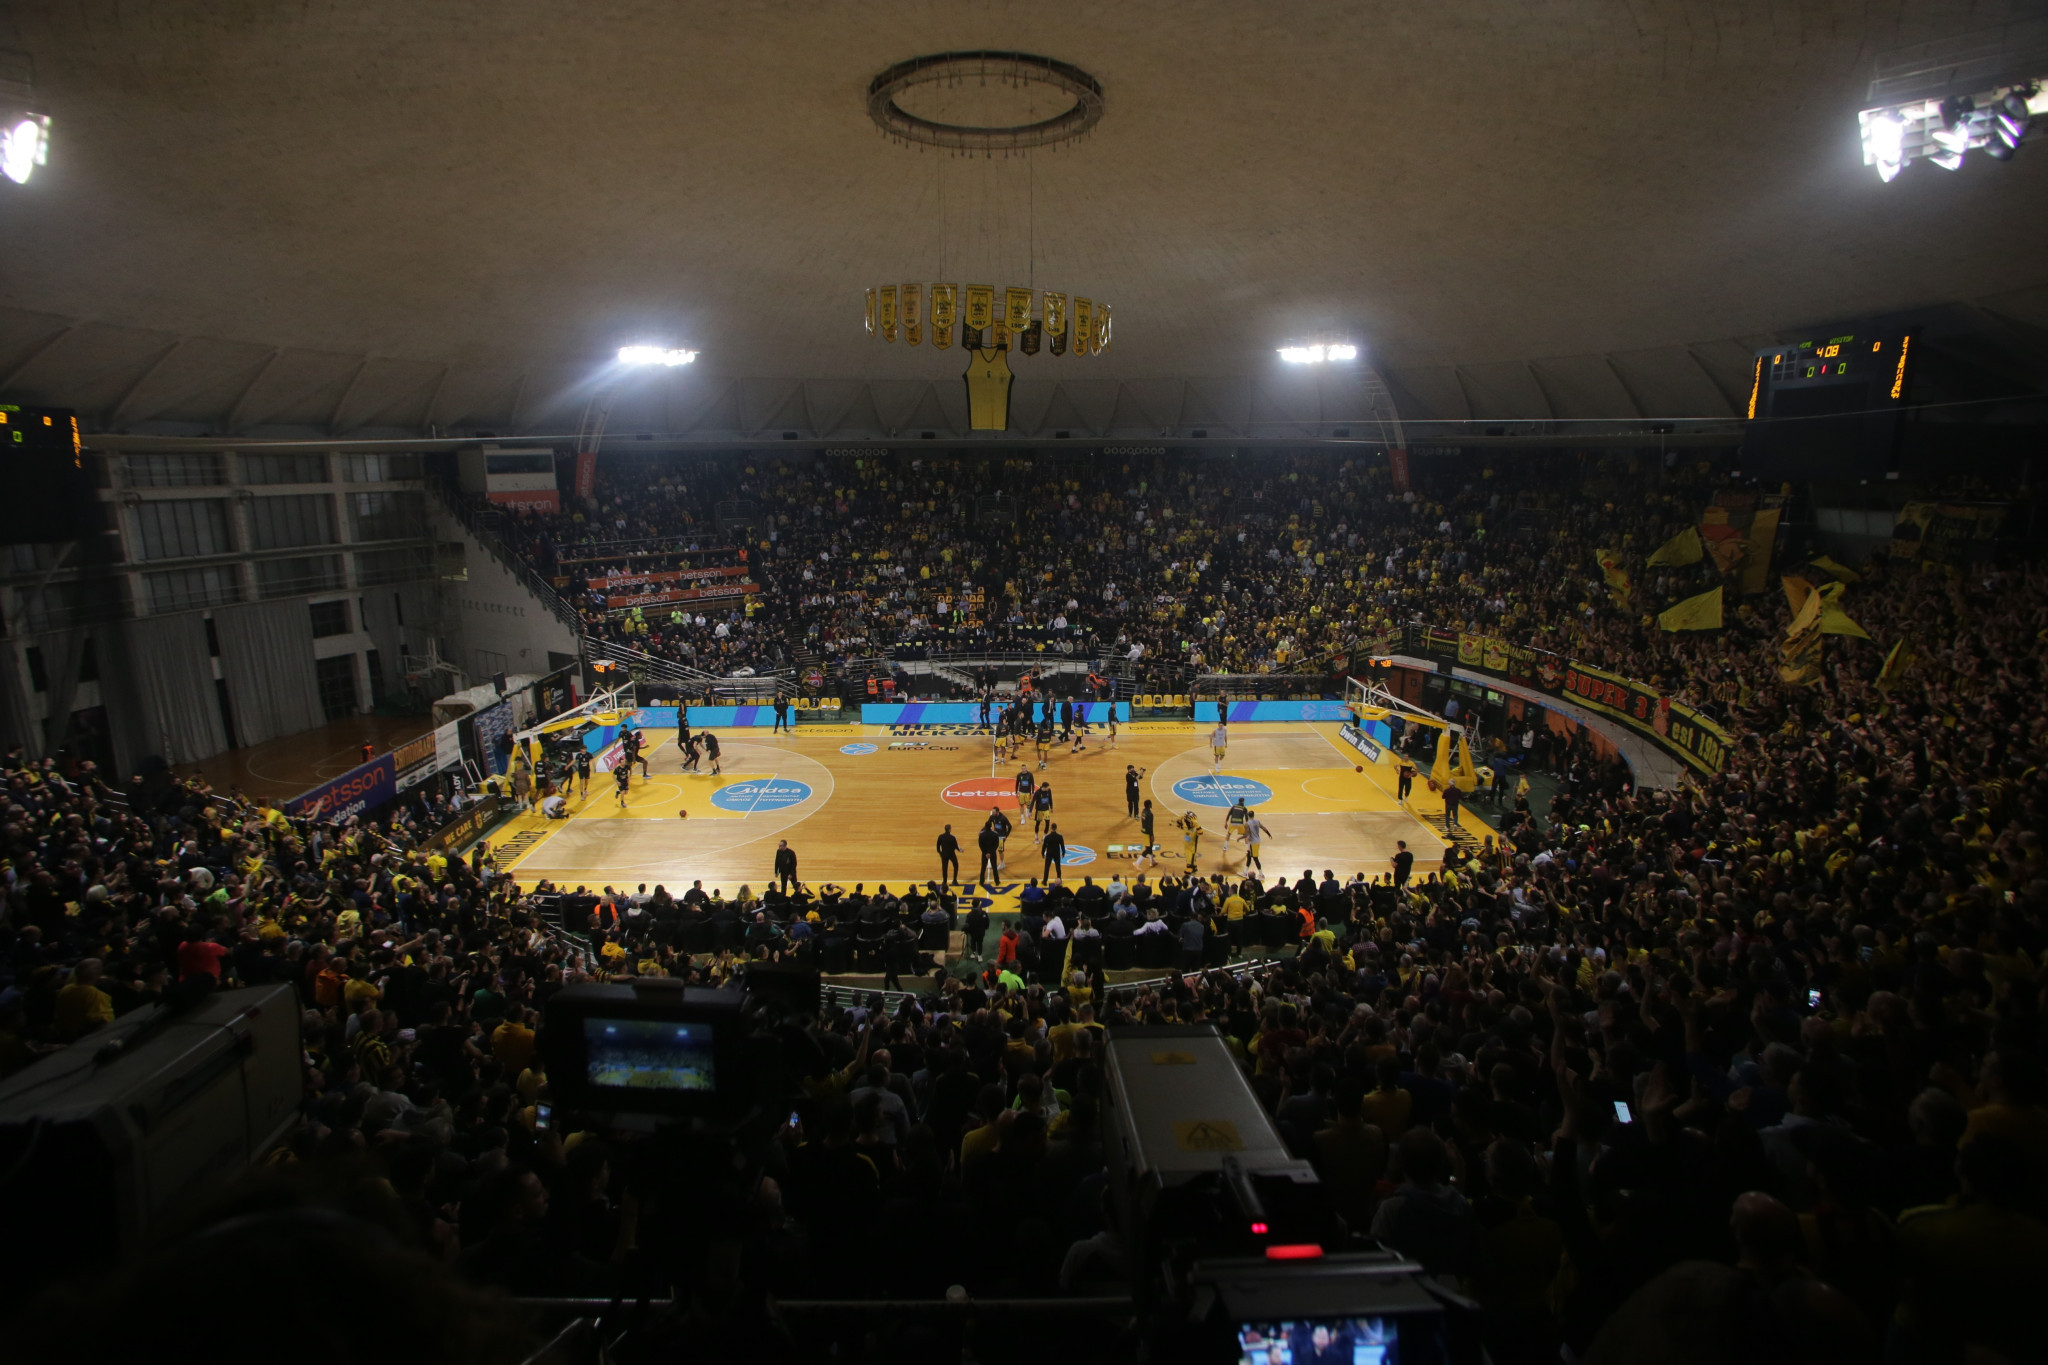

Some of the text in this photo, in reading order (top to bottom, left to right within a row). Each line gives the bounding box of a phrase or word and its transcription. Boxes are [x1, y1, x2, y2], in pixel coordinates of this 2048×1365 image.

[1872, 341, 1881, 352] 0
[1774, 355, 1782, 364] 0
[1837, 363, 1847, 375] 0
[1806, 366, 1815, 378] 0
[680, 569, 722, 580] betsson
[626, 587, 743, 606] betsson betsson
[1565, 669, 1648, 719] SUPER 3
[1340, 725, 1378, 761] bwin bwin
[1671, 721, 1694, 750] est
[303, 766, 386, 813] betsson
[443, 831, 456, 846] WE
[455, 819, 473, 838] CARE
